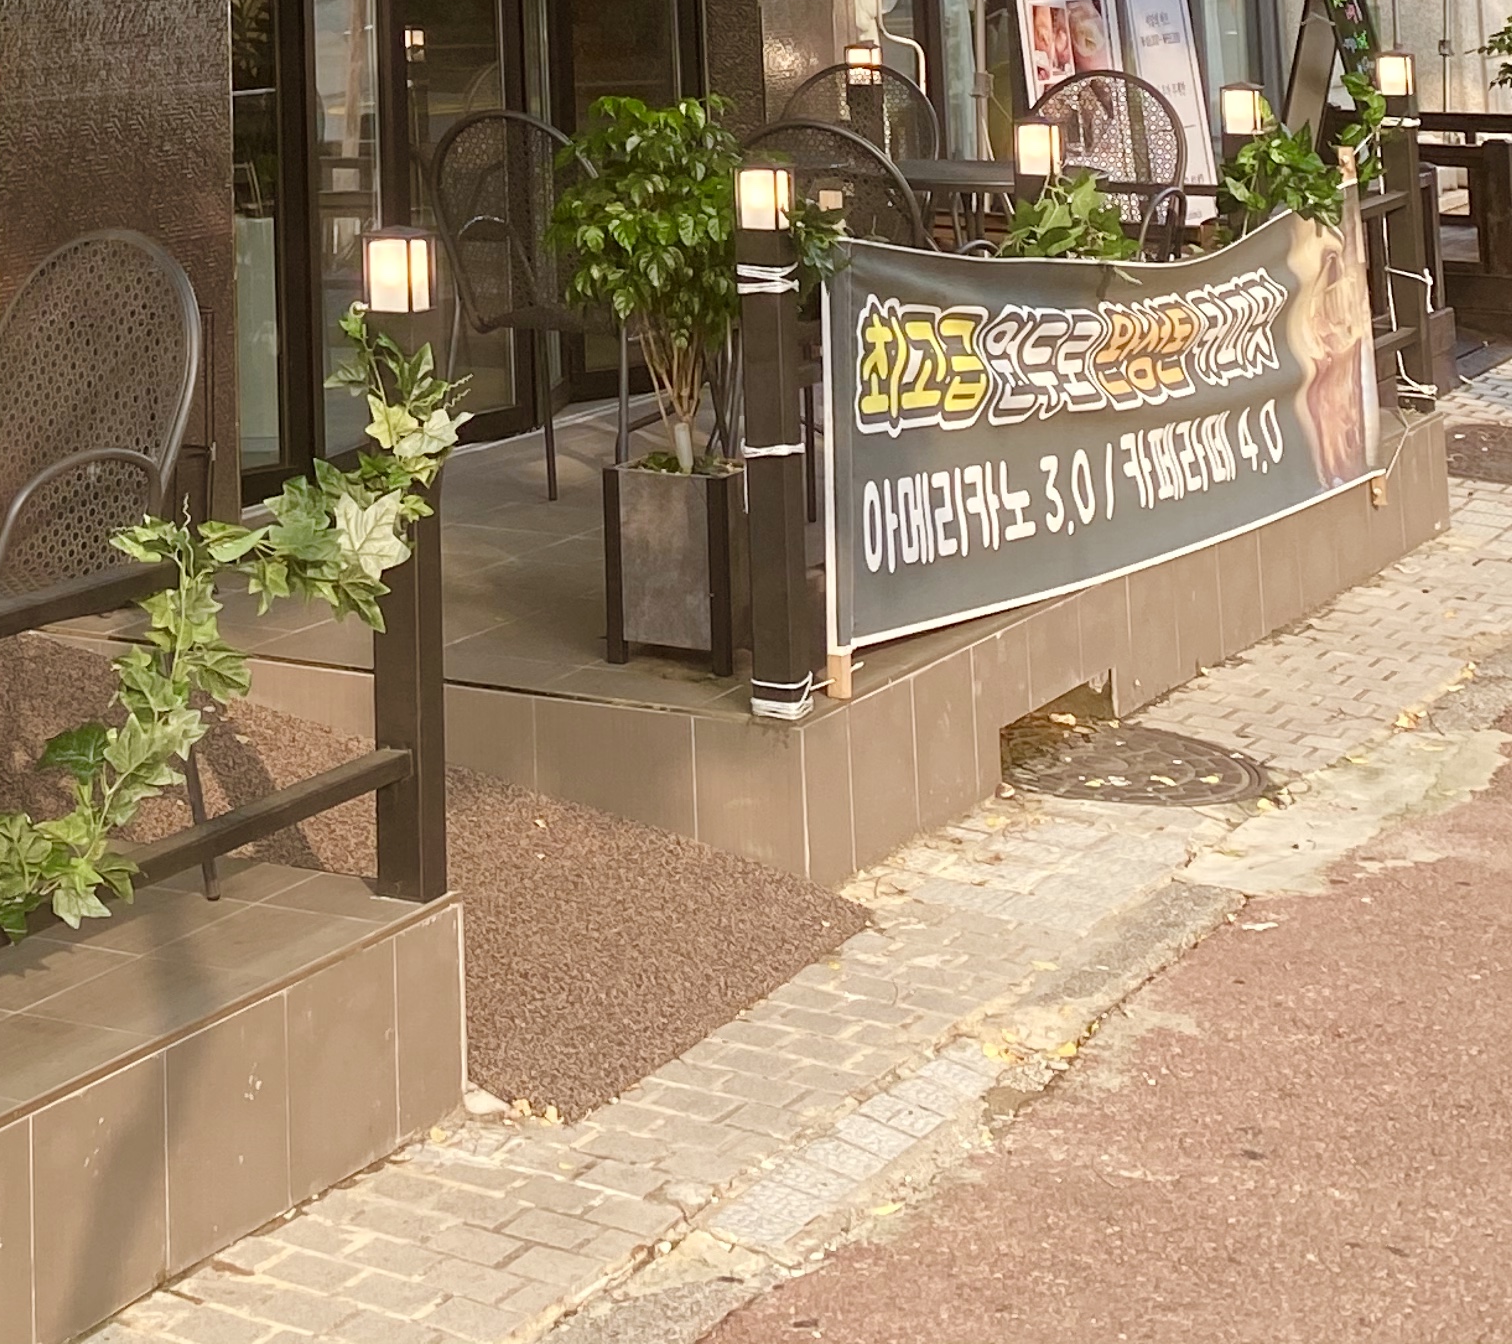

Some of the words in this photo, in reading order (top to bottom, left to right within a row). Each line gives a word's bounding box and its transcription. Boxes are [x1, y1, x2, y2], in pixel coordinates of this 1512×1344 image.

[858, 302, 989, 424] 최고급
[987, 312, 1100, 417] 원두로
[862, 458, 1036, 574] 아메리카노
[1039, 447, 1097, 536] 3.0
[1119, 412, 1237, 510] 카페라떼
[1239, 400, 1284, 474] 4.0
